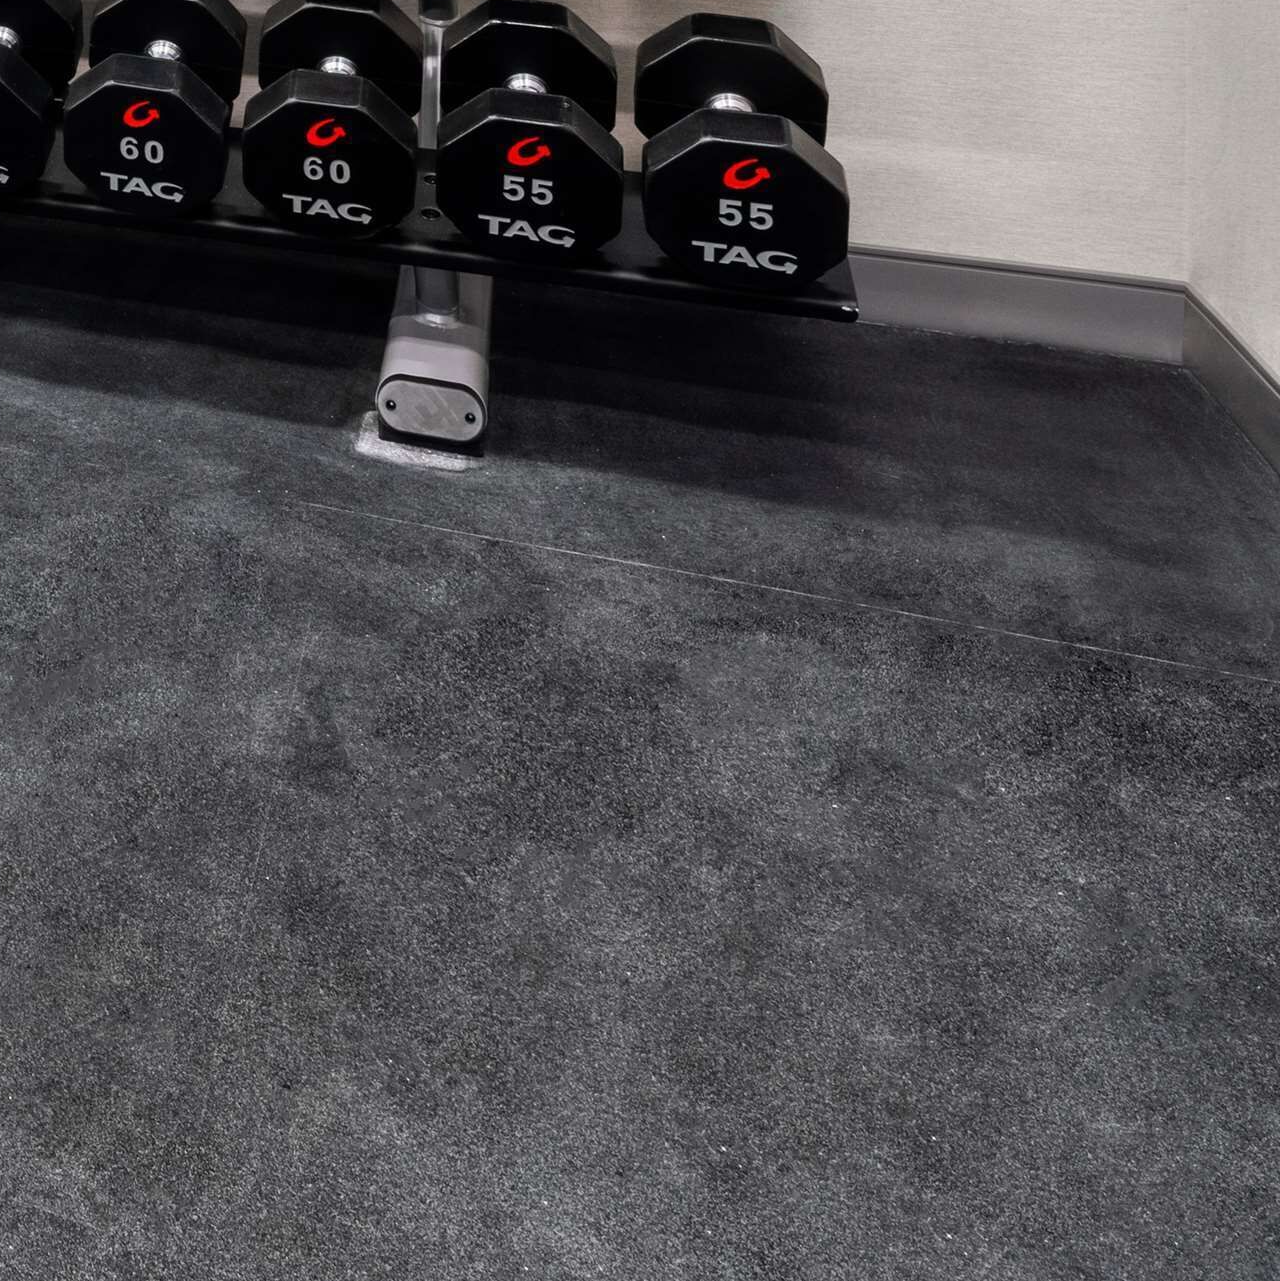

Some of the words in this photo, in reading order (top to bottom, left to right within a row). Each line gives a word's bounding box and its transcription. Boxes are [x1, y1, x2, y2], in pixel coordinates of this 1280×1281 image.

[120, 136, 164, 164] 60
[303, 156, 350, 184] 60
[100, 171, 184, 203] TAG
[503, 175, 553, 205] 55
[282, 194, 372, 224] TAG
[718, 198, 773, 230] 55
[478, 214, 575, 248] TAG
[691, 240, 798, 274] TAG
